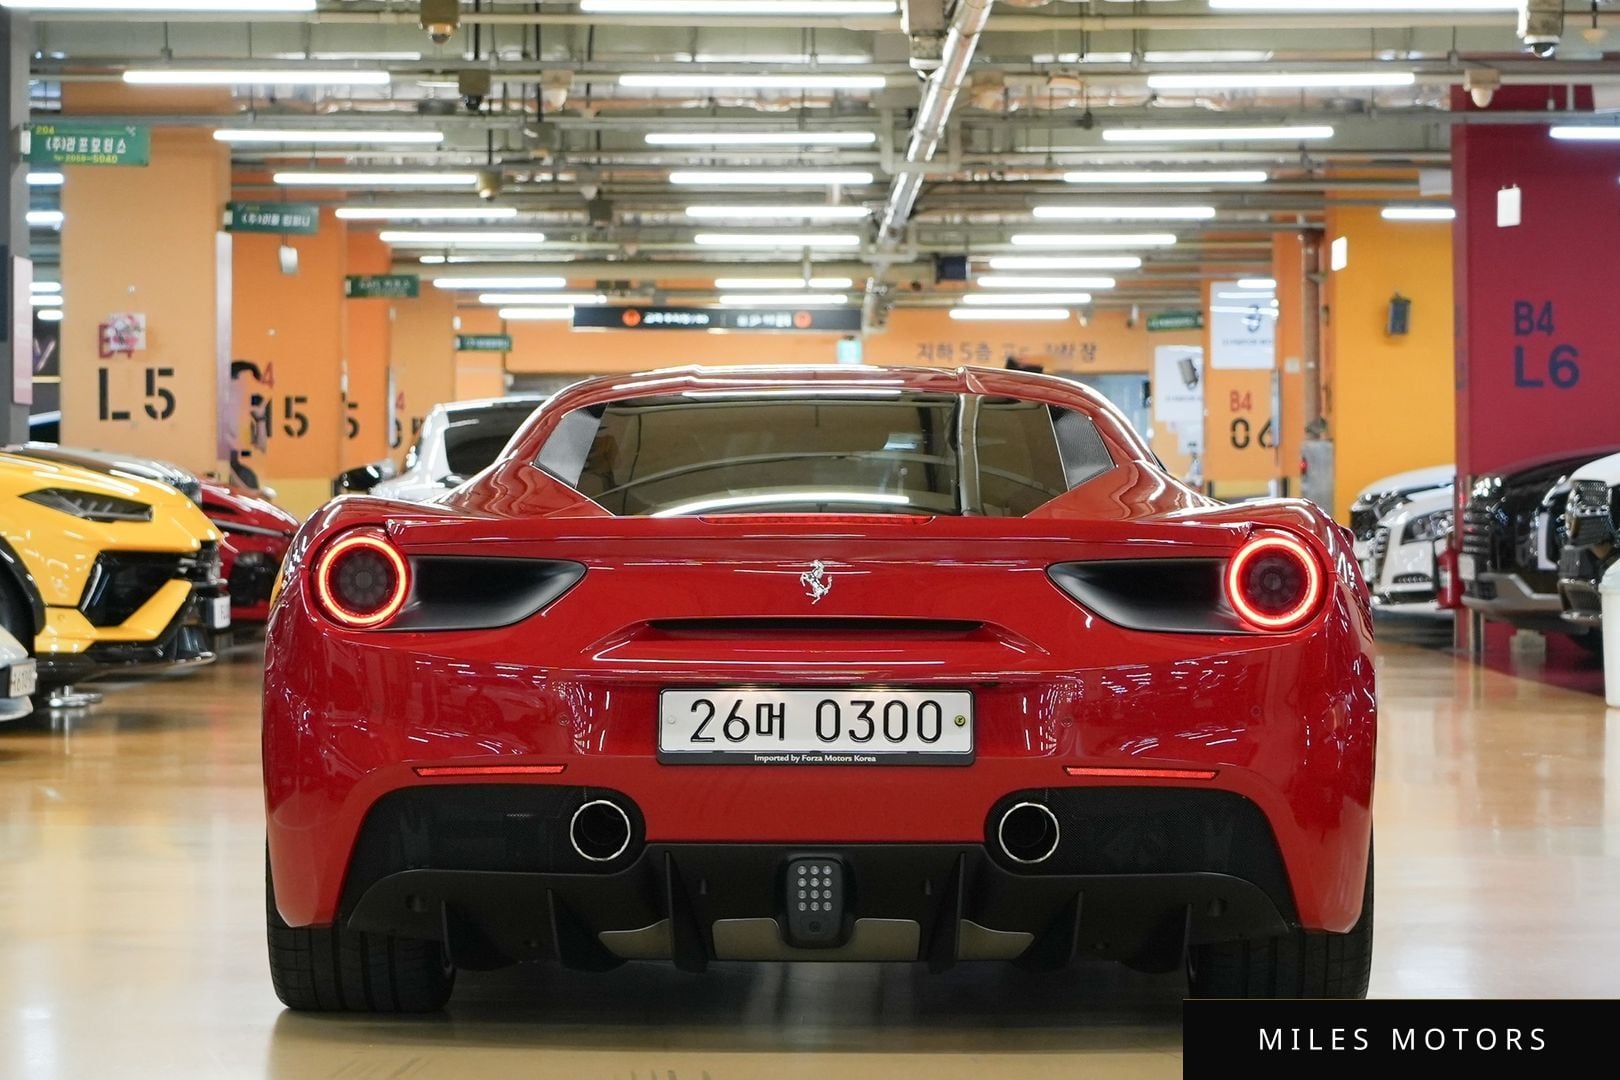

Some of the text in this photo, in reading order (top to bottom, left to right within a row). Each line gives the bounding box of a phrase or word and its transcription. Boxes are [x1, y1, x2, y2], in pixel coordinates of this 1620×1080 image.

[1515, 300, 1554, 336] B4
[1515, 344, 1580, 389] L6
[1229, 390, 1252, 412] B4
[690, 698, 942, 743] 26머 0300
[754, 754, 877, 763] Imported by Forza Motors Korea
